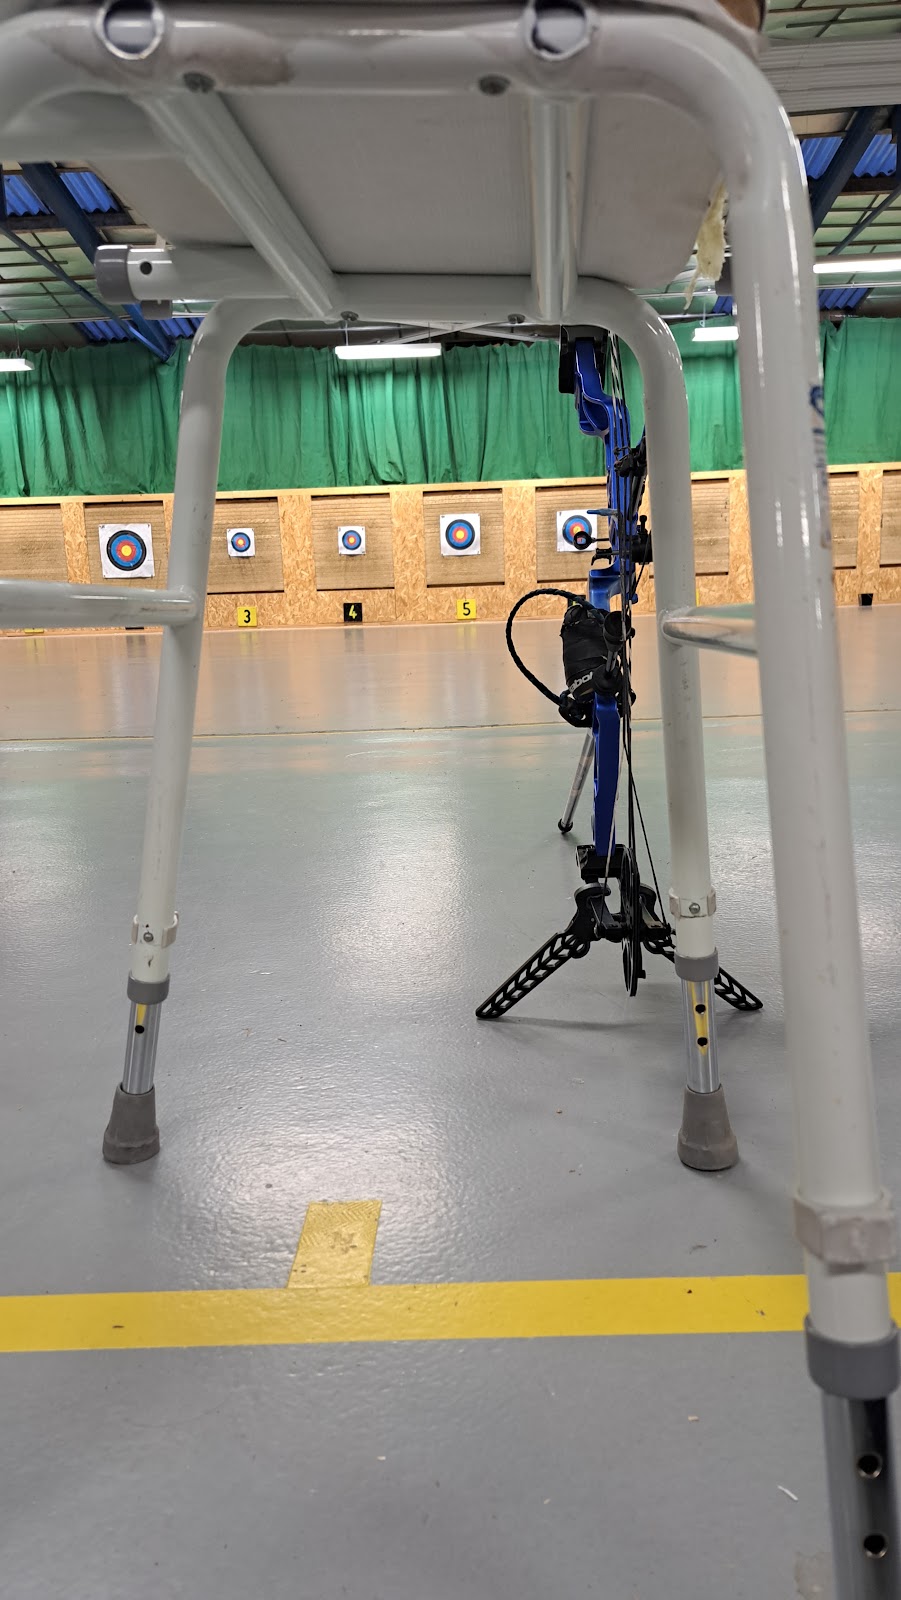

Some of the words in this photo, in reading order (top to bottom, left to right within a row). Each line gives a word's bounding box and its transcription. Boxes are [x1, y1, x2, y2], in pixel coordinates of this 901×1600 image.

[349, 605, 357, 619] 4
[463, 602, 471, 616] 5
[243, 609, 251, 624] 3
